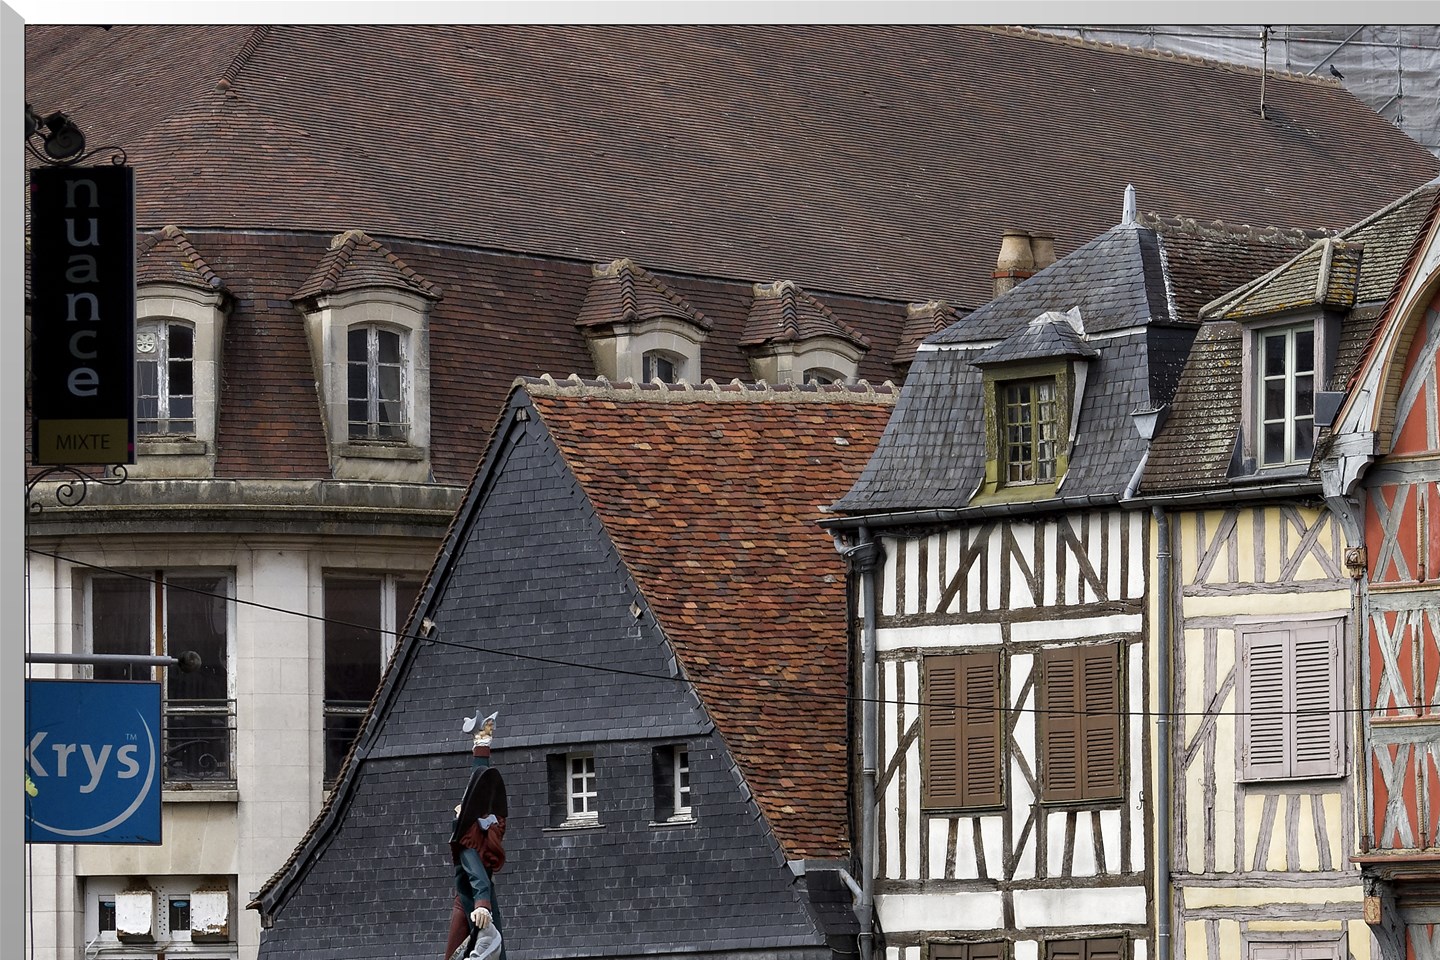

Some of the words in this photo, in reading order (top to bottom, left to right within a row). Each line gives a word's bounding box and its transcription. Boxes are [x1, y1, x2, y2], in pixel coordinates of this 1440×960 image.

[64, 178, 100, 396] nuance
[56, 434, 110, 450] MIXTE
[26, 732, 140, 793] Krys
